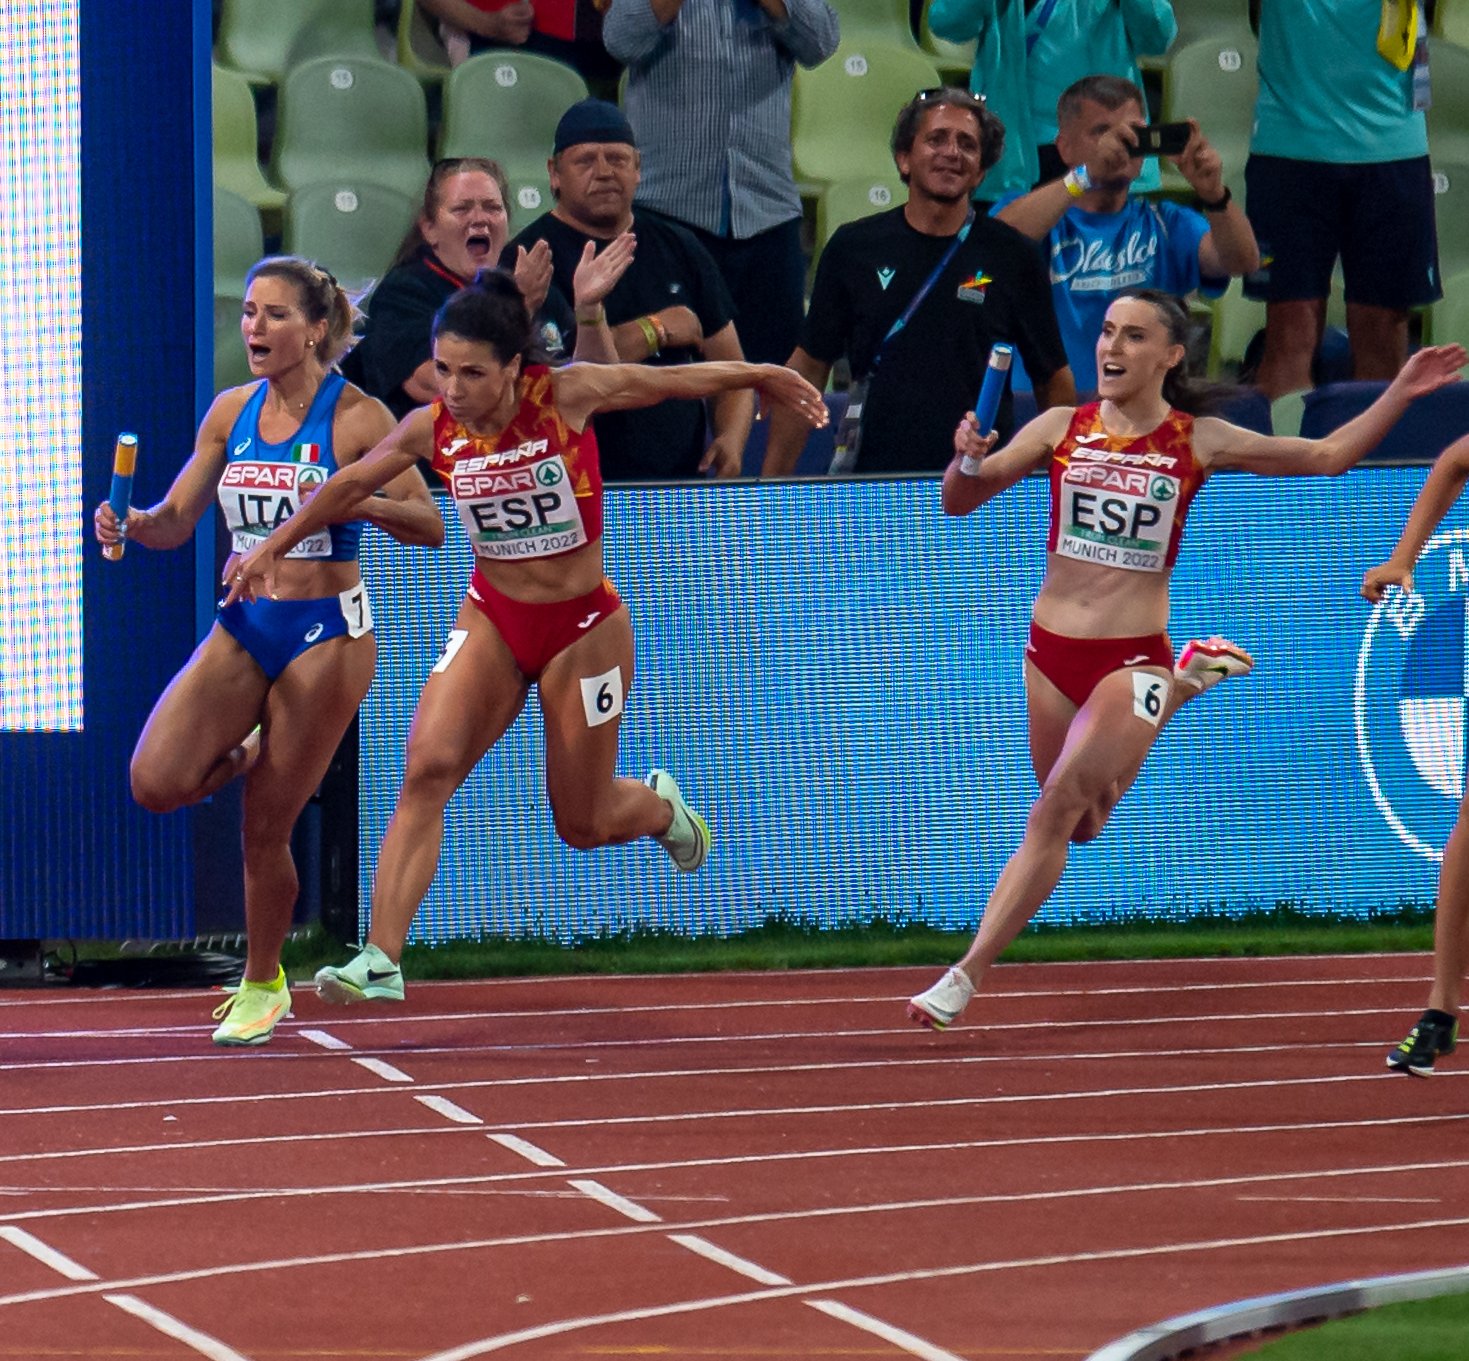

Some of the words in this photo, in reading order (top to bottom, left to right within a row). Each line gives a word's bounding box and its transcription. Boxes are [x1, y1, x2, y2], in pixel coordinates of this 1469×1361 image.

[225, 466, 295, 487] SPAR
[456, 472, 534, 496] SPAR
[1067, 467, 1147, 493] SPAR
[237, 494, 296, 530] ITA
[469, 492, 562, 532] ESP
[1072, 491, 1162, 538] ESP
[480, 540, 537, 556] MUNICH
[541, 532, 579, 551] 2022
[1062, 538, 1118, 562] MUNICH
[1122, 552, 1160, 568] 2022
[351, 592, 363, 629] 7
[597, 682, 614, 714] 6
[1144, 683, 1162, 717] 6
